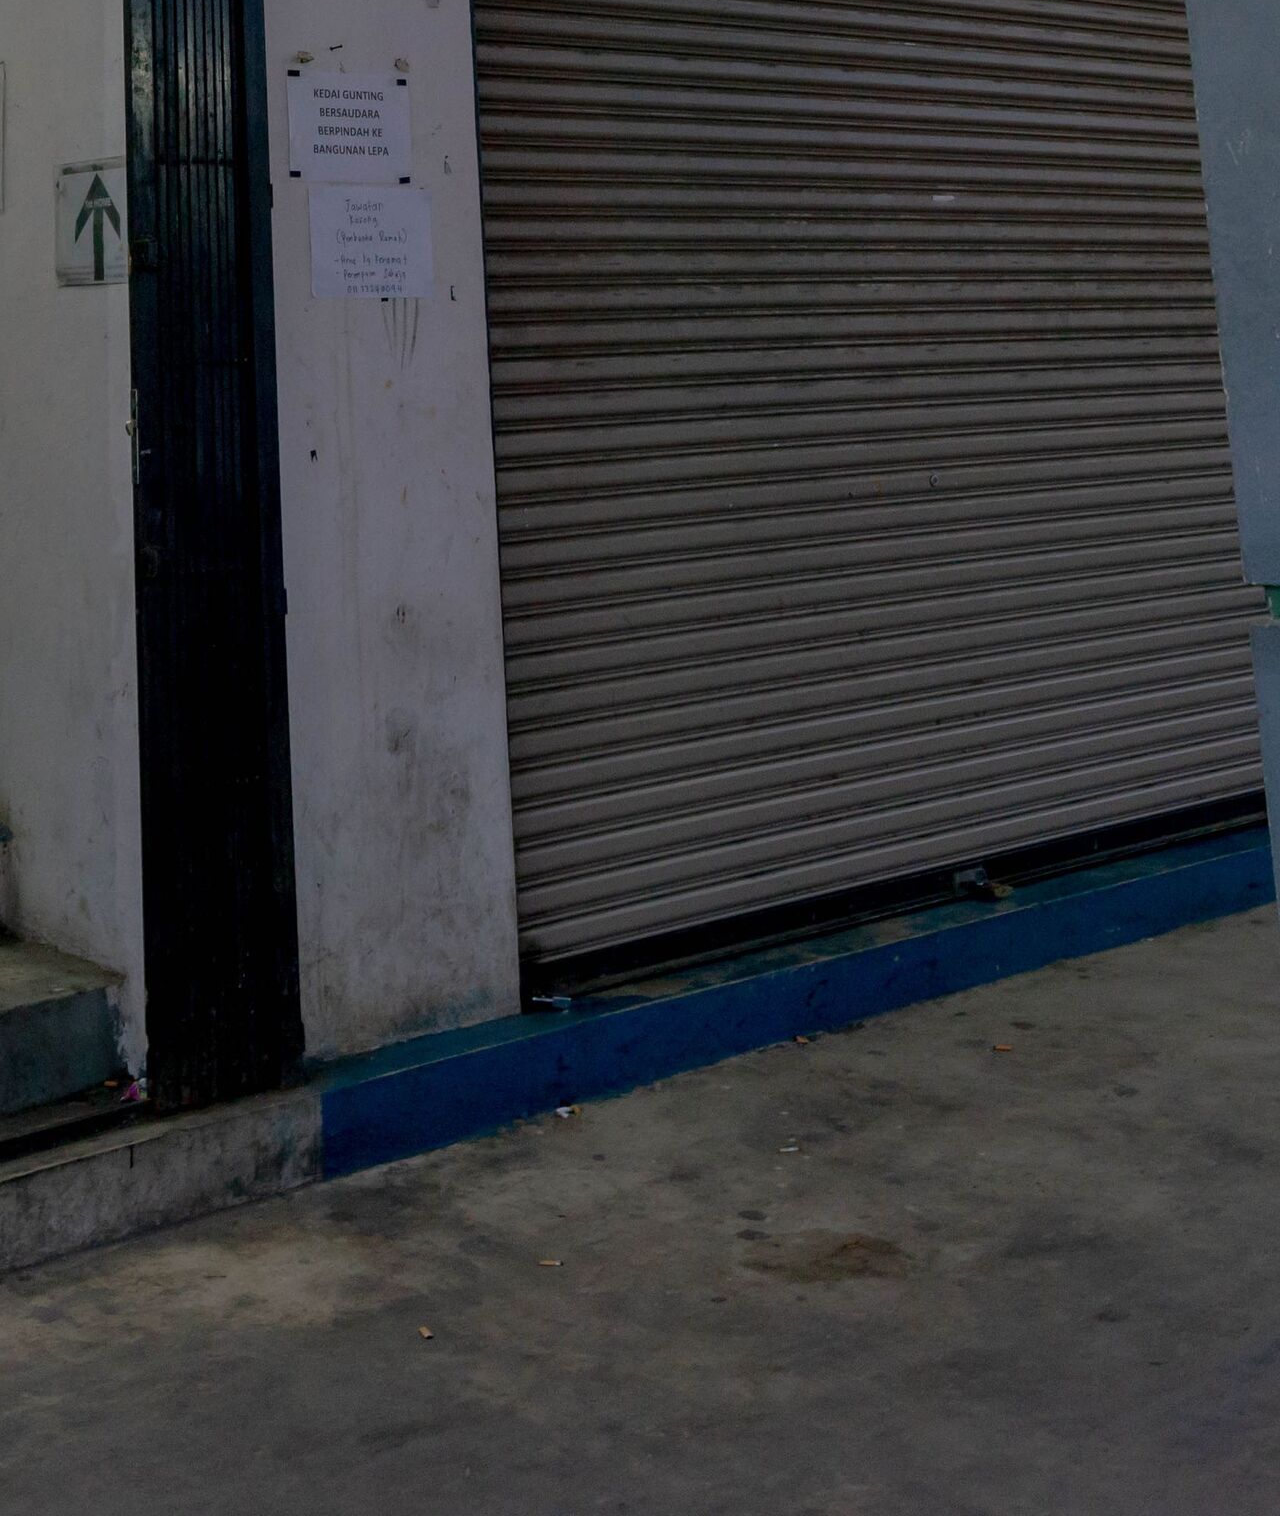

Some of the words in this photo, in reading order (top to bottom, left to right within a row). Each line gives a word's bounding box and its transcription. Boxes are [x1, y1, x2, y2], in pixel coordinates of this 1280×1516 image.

[313, 88, 340, 98] KEDAI
[342, 90, 384, 101] GUNTING
[319, 107, 380, 119] BERSAUDARA
[318, 126, 369, 137] BERPINDAH
[372, 128, 382, 137] KE
[313, 144, 365, 155] BANGUNAN
[368, 146, 389, 156] LEPA
